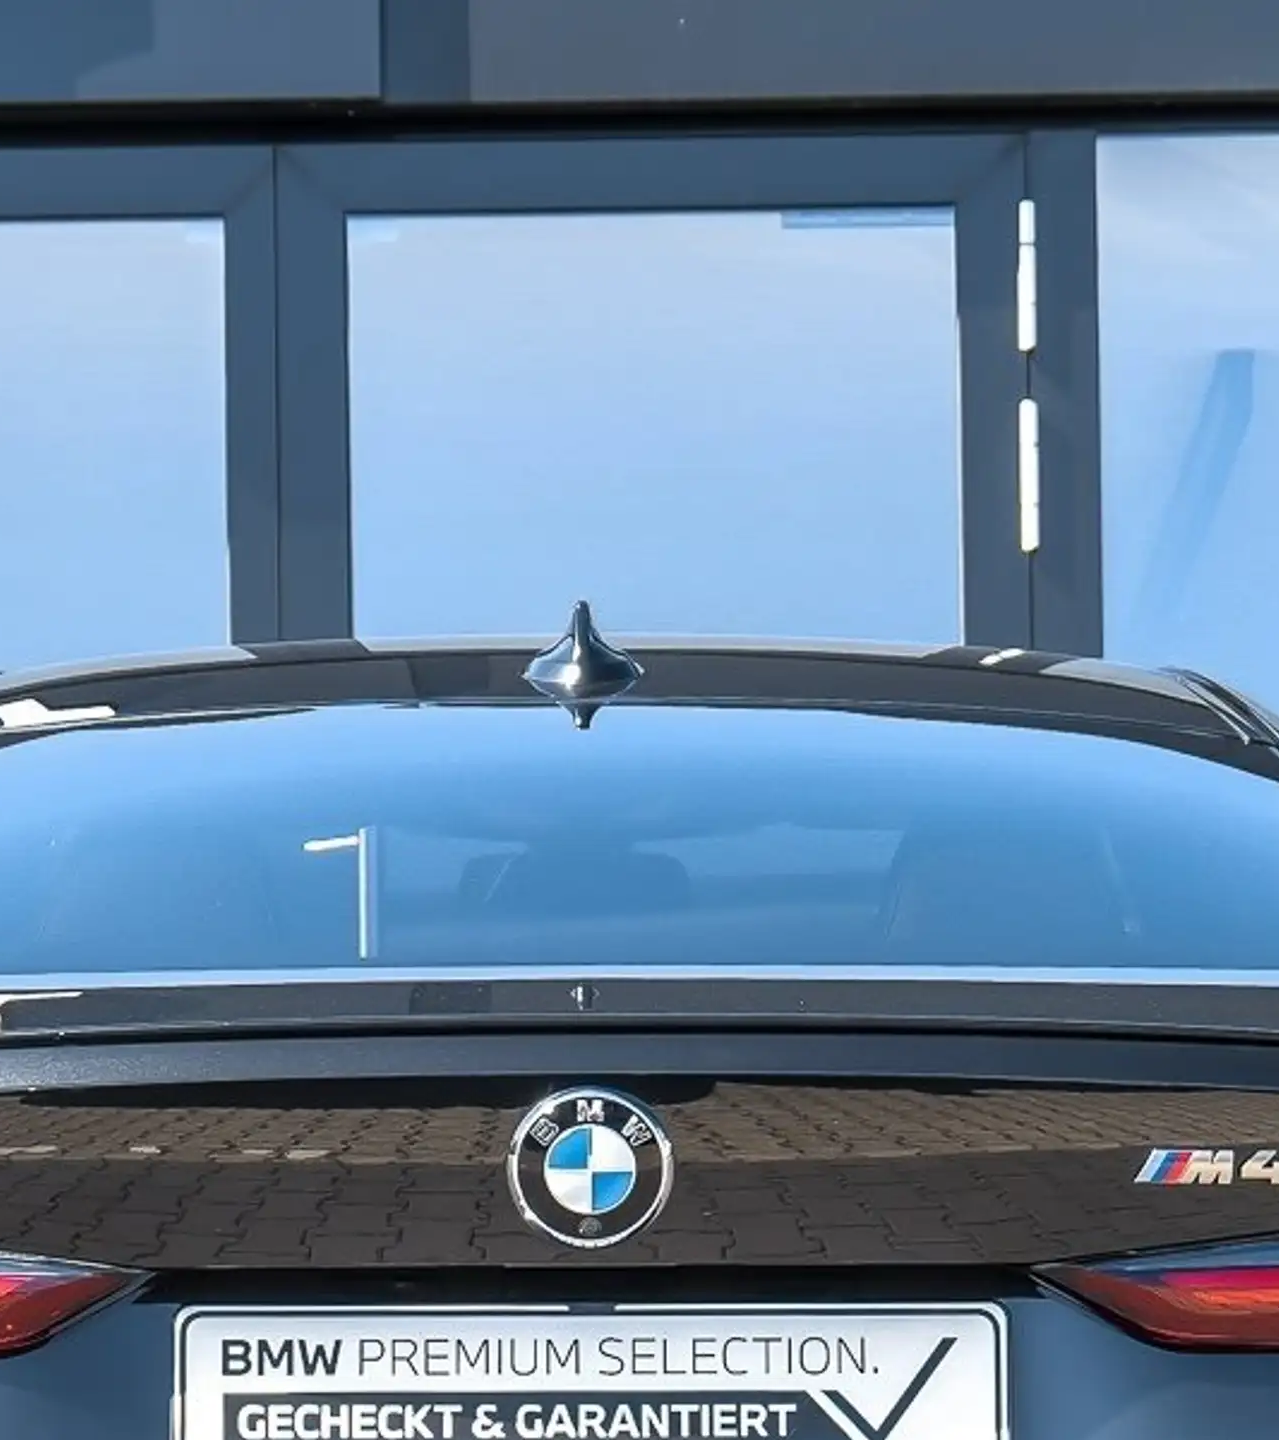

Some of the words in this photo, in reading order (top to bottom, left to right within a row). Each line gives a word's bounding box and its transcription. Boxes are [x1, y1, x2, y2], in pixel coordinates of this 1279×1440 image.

[529, 1099, 653, 1147] BMW
[221, 1338, 342, 1377] BMW
[358, 1337, 581, 1376] PREMIUM
[598, 1335, 880, 1376] SELECTION.
[236, 1403, 463, 1440] GECHECKT
[471, 1403, 507, 1439] &
[515, 1402, 797, 1440] GARANTIERT
